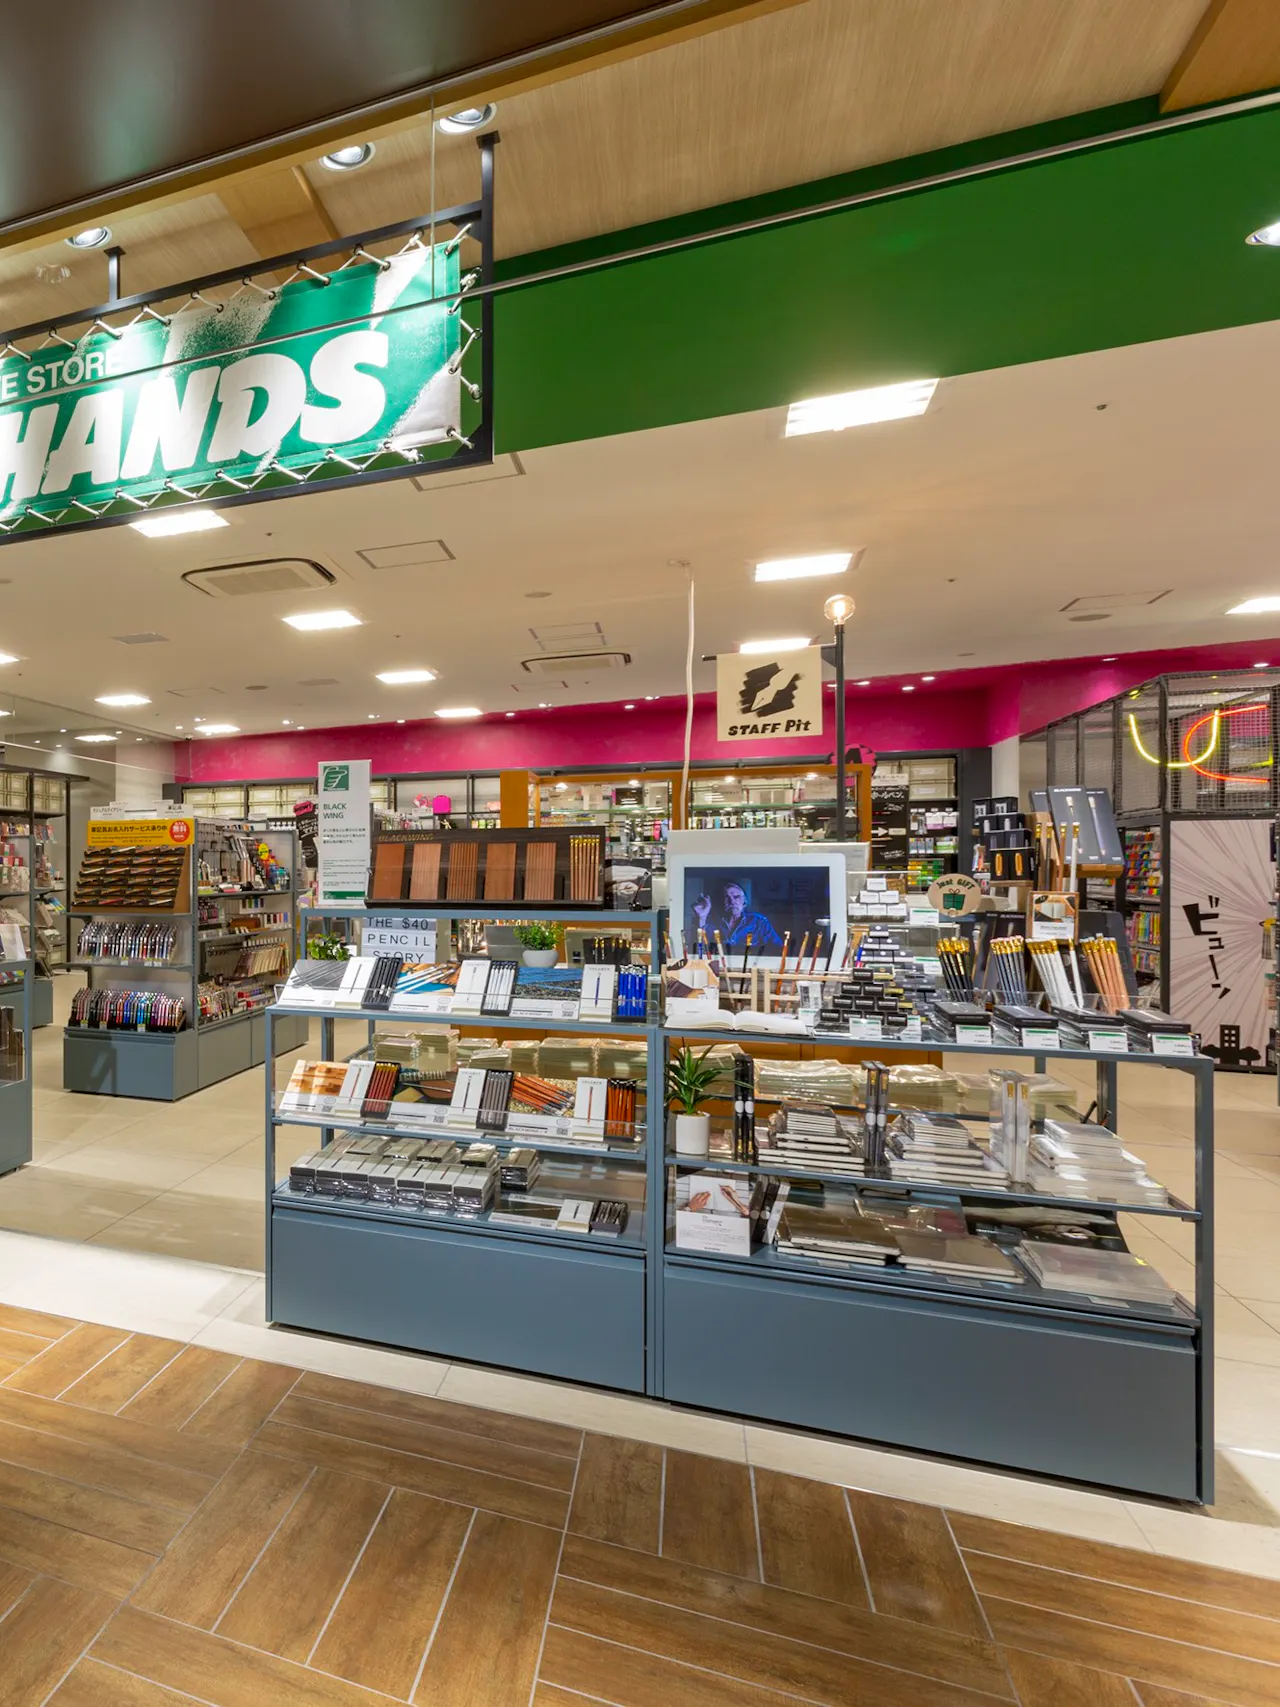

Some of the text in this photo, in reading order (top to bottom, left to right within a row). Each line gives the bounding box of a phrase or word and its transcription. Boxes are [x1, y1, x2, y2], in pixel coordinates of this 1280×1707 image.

[26, 349, 122, 394] STORE
[728, 719, 812, 736] STAFF Pit
[957, 878, 976, 890] GIFT
[367, 917, 429, 930] THE $40
[367, 933, 431, 946] PENCIL
